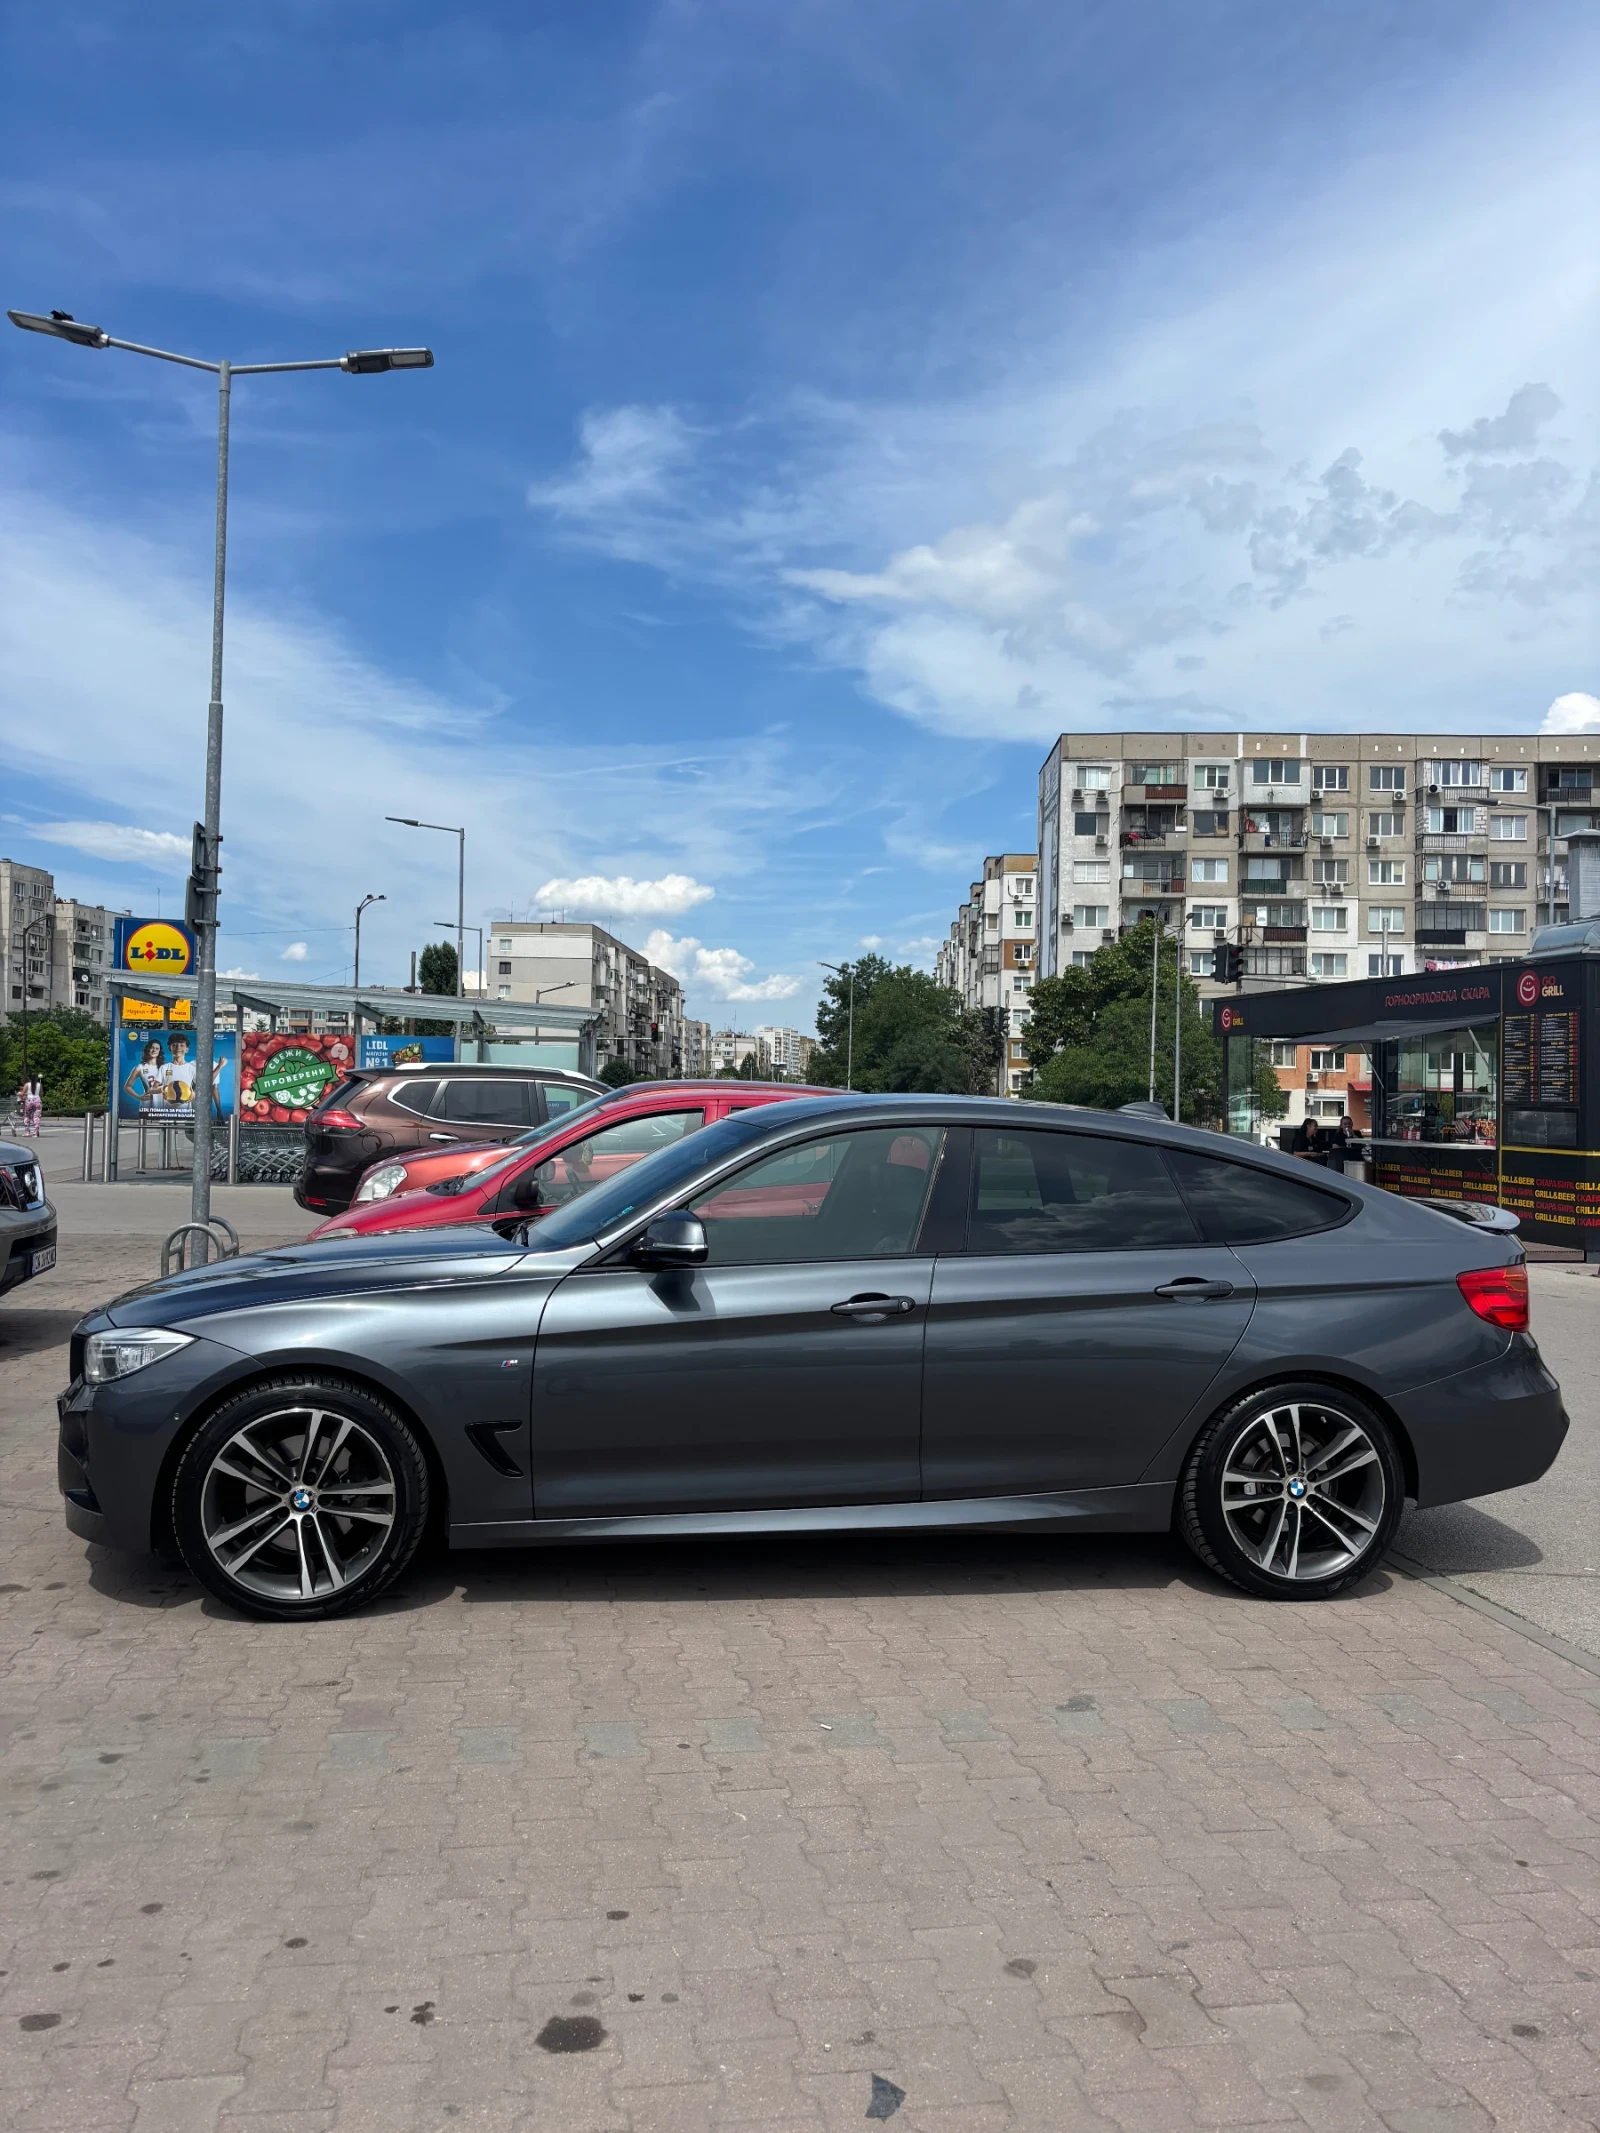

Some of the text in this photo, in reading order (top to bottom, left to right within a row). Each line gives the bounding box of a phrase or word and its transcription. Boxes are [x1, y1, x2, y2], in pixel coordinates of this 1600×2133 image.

[1541, 975, 1556, 986] GO
[1385, 986, 1490, 1007] ГОРНООРЯХОВСКА СКАРА
[1541, 985, 1564, 997] GRILL
[366, 1040, 388, 1050] LIDL
[268, 1050, 314, 1070] СВЕЖИ И
[263, 1067, 326, 1088] ПРОВЕРЕНИ
[1463, 1181, 1498, 1192] GRILL&BEER
[1535, 1190, 1575, 1201] GRILL&BEER
[1535, 1212, 1575, 1225] GRILL&BEER
